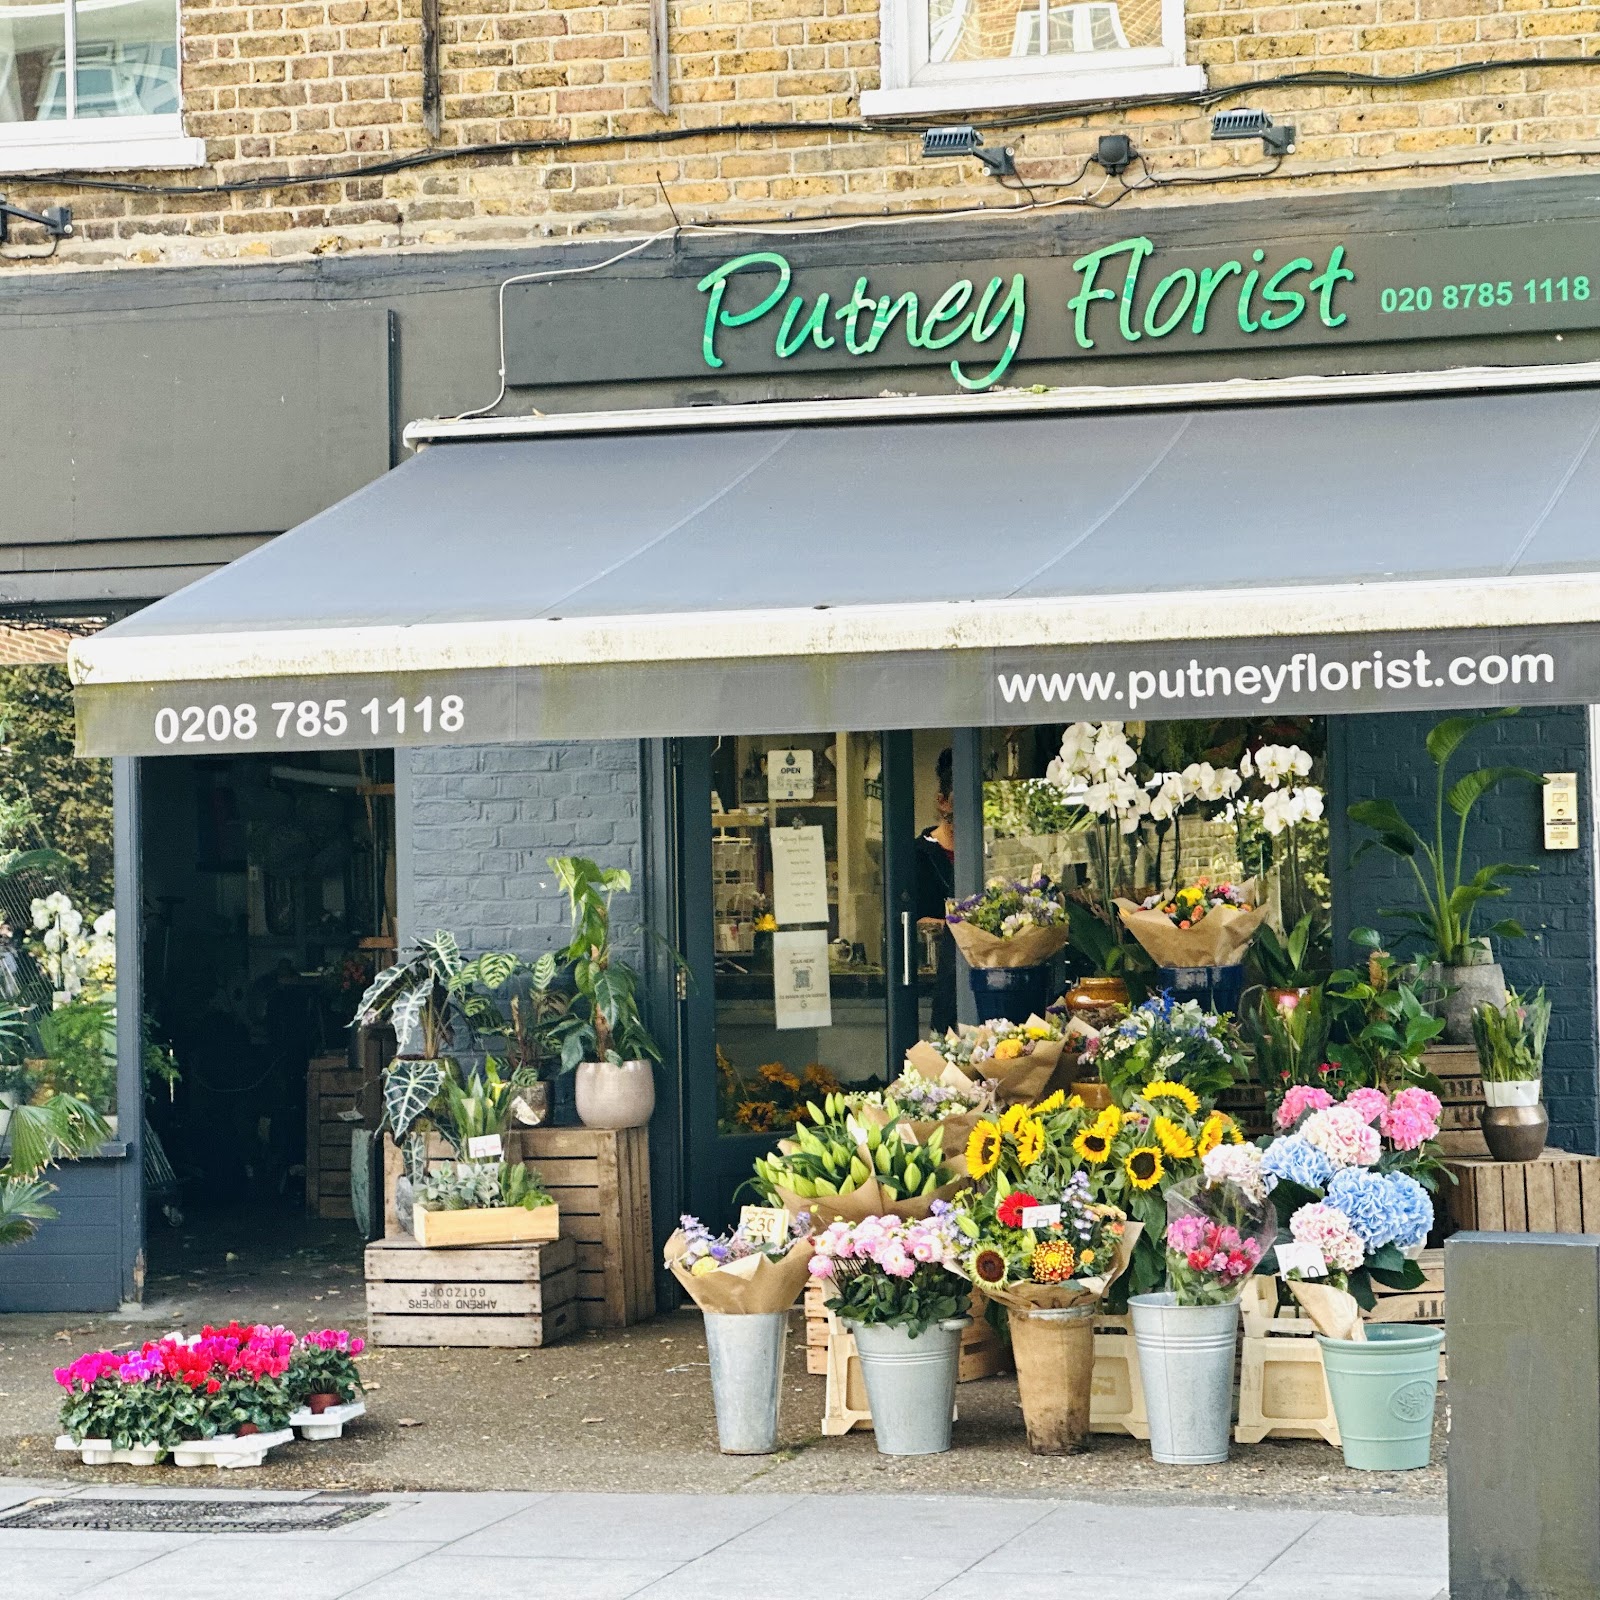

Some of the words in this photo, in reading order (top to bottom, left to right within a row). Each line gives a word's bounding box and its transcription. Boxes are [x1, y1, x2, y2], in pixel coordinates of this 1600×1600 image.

[698, 251, 1026, 391] Putney
[1068, 237, 1357, 349] Florist
[1381, 287, 1433, 313] 020
[1442, 281, 1513, 310] 8785
[1523, 275, 1591, 304] 1118
[997, 650, 1555, 709] www.putneyflorist.com
[154, 703, 258, 745] 0208
[271, 699, 349, 739] 785
[360, 694, 466, 735] 1118
